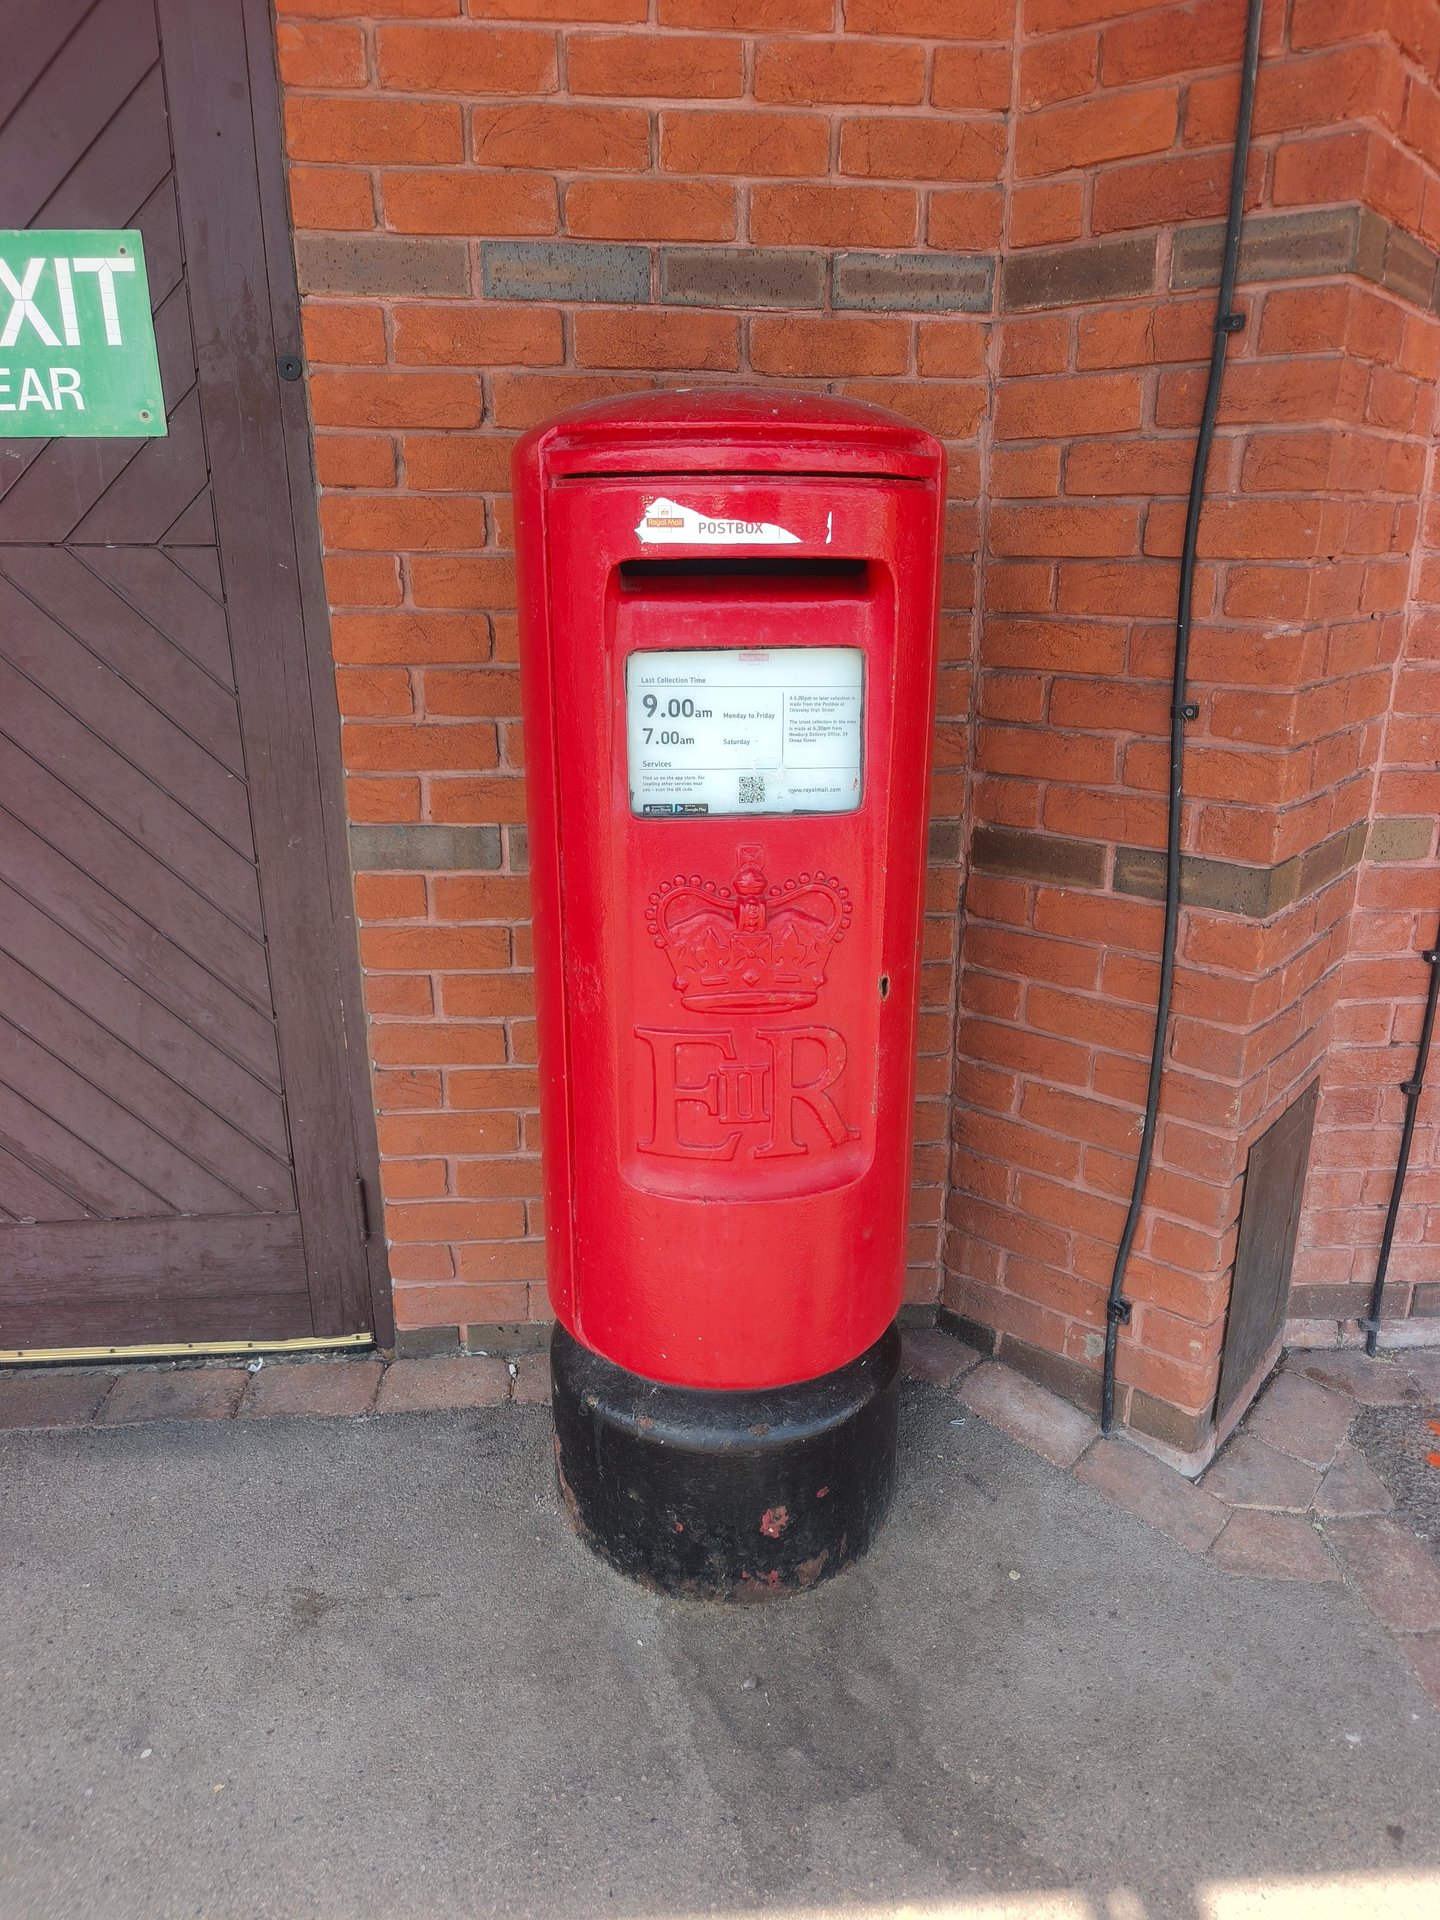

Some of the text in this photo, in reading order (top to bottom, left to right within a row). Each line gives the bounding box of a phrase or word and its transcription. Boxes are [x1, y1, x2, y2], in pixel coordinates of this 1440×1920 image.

[648, 518, 667, 526] Royal
[698, 522, 764, 534] POSTBOX
[642, 694, 713, 718] 9.00am
[642, 728, 695, 744] 7.00am
